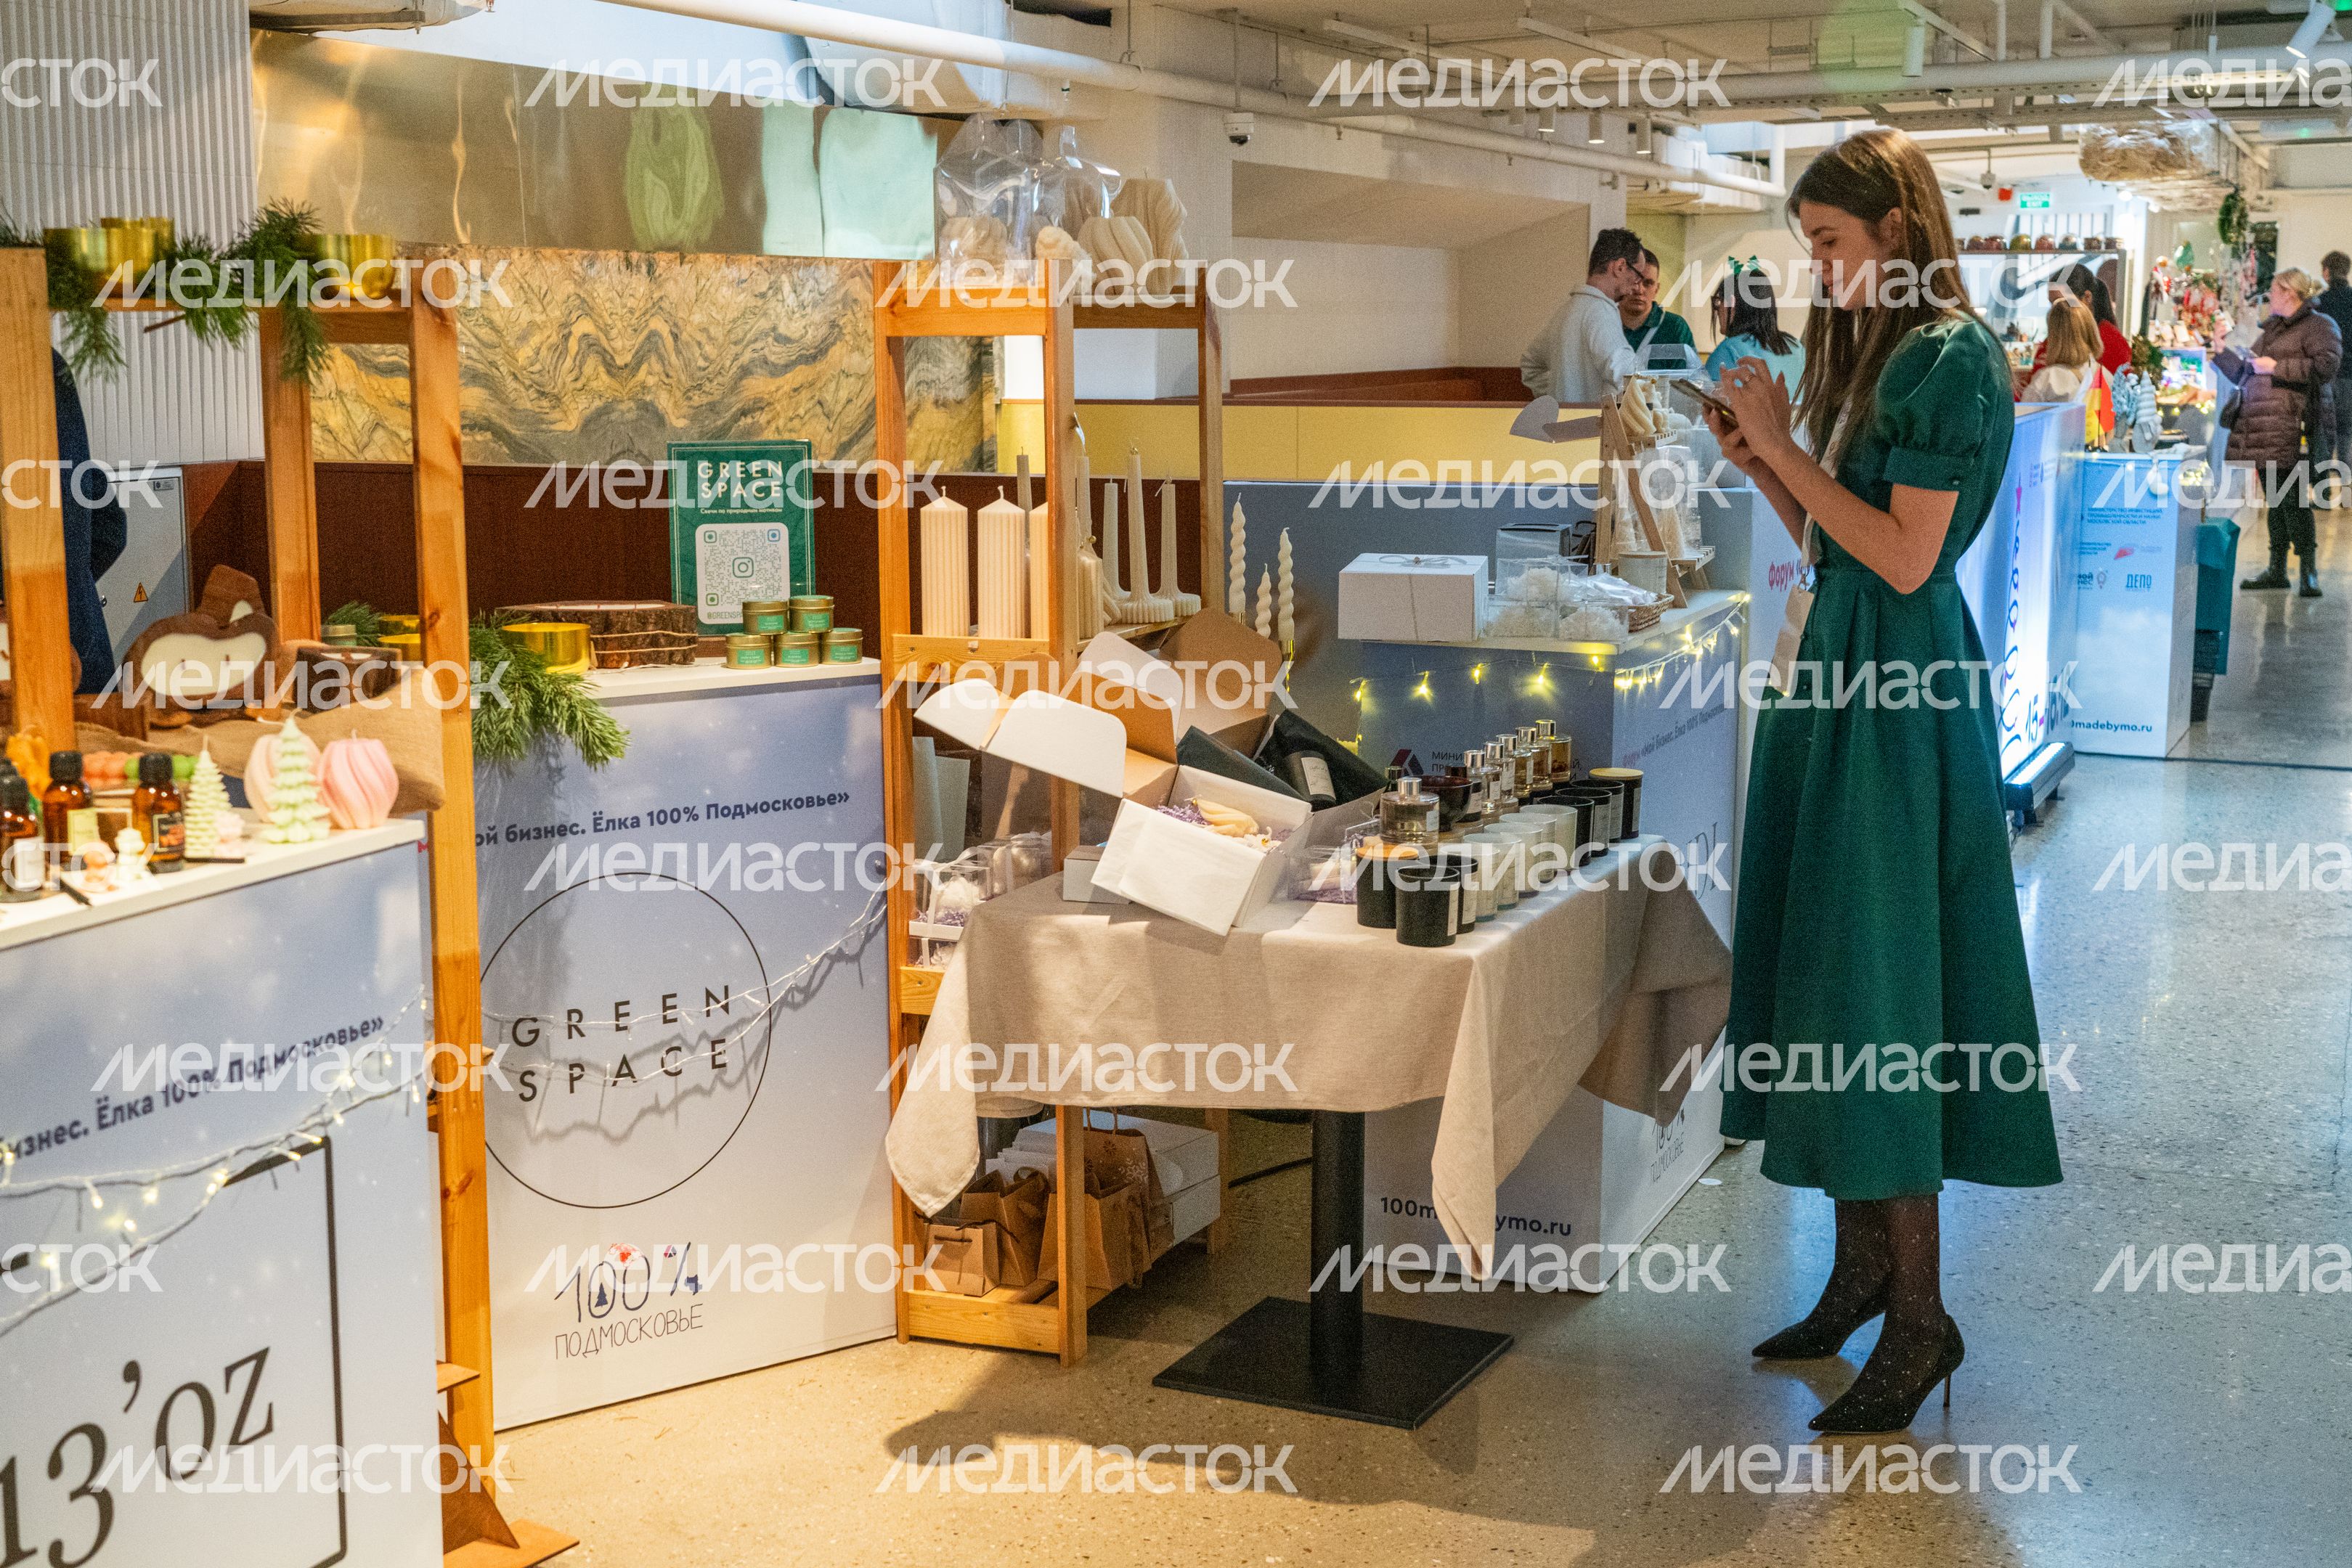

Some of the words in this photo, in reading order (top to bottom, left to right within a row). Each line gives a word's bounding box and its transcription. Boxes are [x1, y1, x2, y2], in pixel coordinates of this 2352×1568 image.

[698, 460, 782, 478] GREEN
[701, 481, 781, 499] SPACE
[2125, 573, 2152, 588] ДЕПО
[475, 825, 498, 846] ой
[505, 823, 586, 843] бизнес.
[593, 810, 640, 833] Ёлка
[647, 806, 699, 827] 100%
[706, 791, 850, 820] Подмосковье»
[512, 985, 729, 1048] GREEN
[96, 1095, 155, 1131] Ёлка
[162, 1066, 221, 1108] 100%
[228, 1016, 383, 1083] Подмосковье»
[518, 1038, 727, 1102] SPACE
[555, 1303, 703, 1360] ПОДМОСКОВЬЕ
